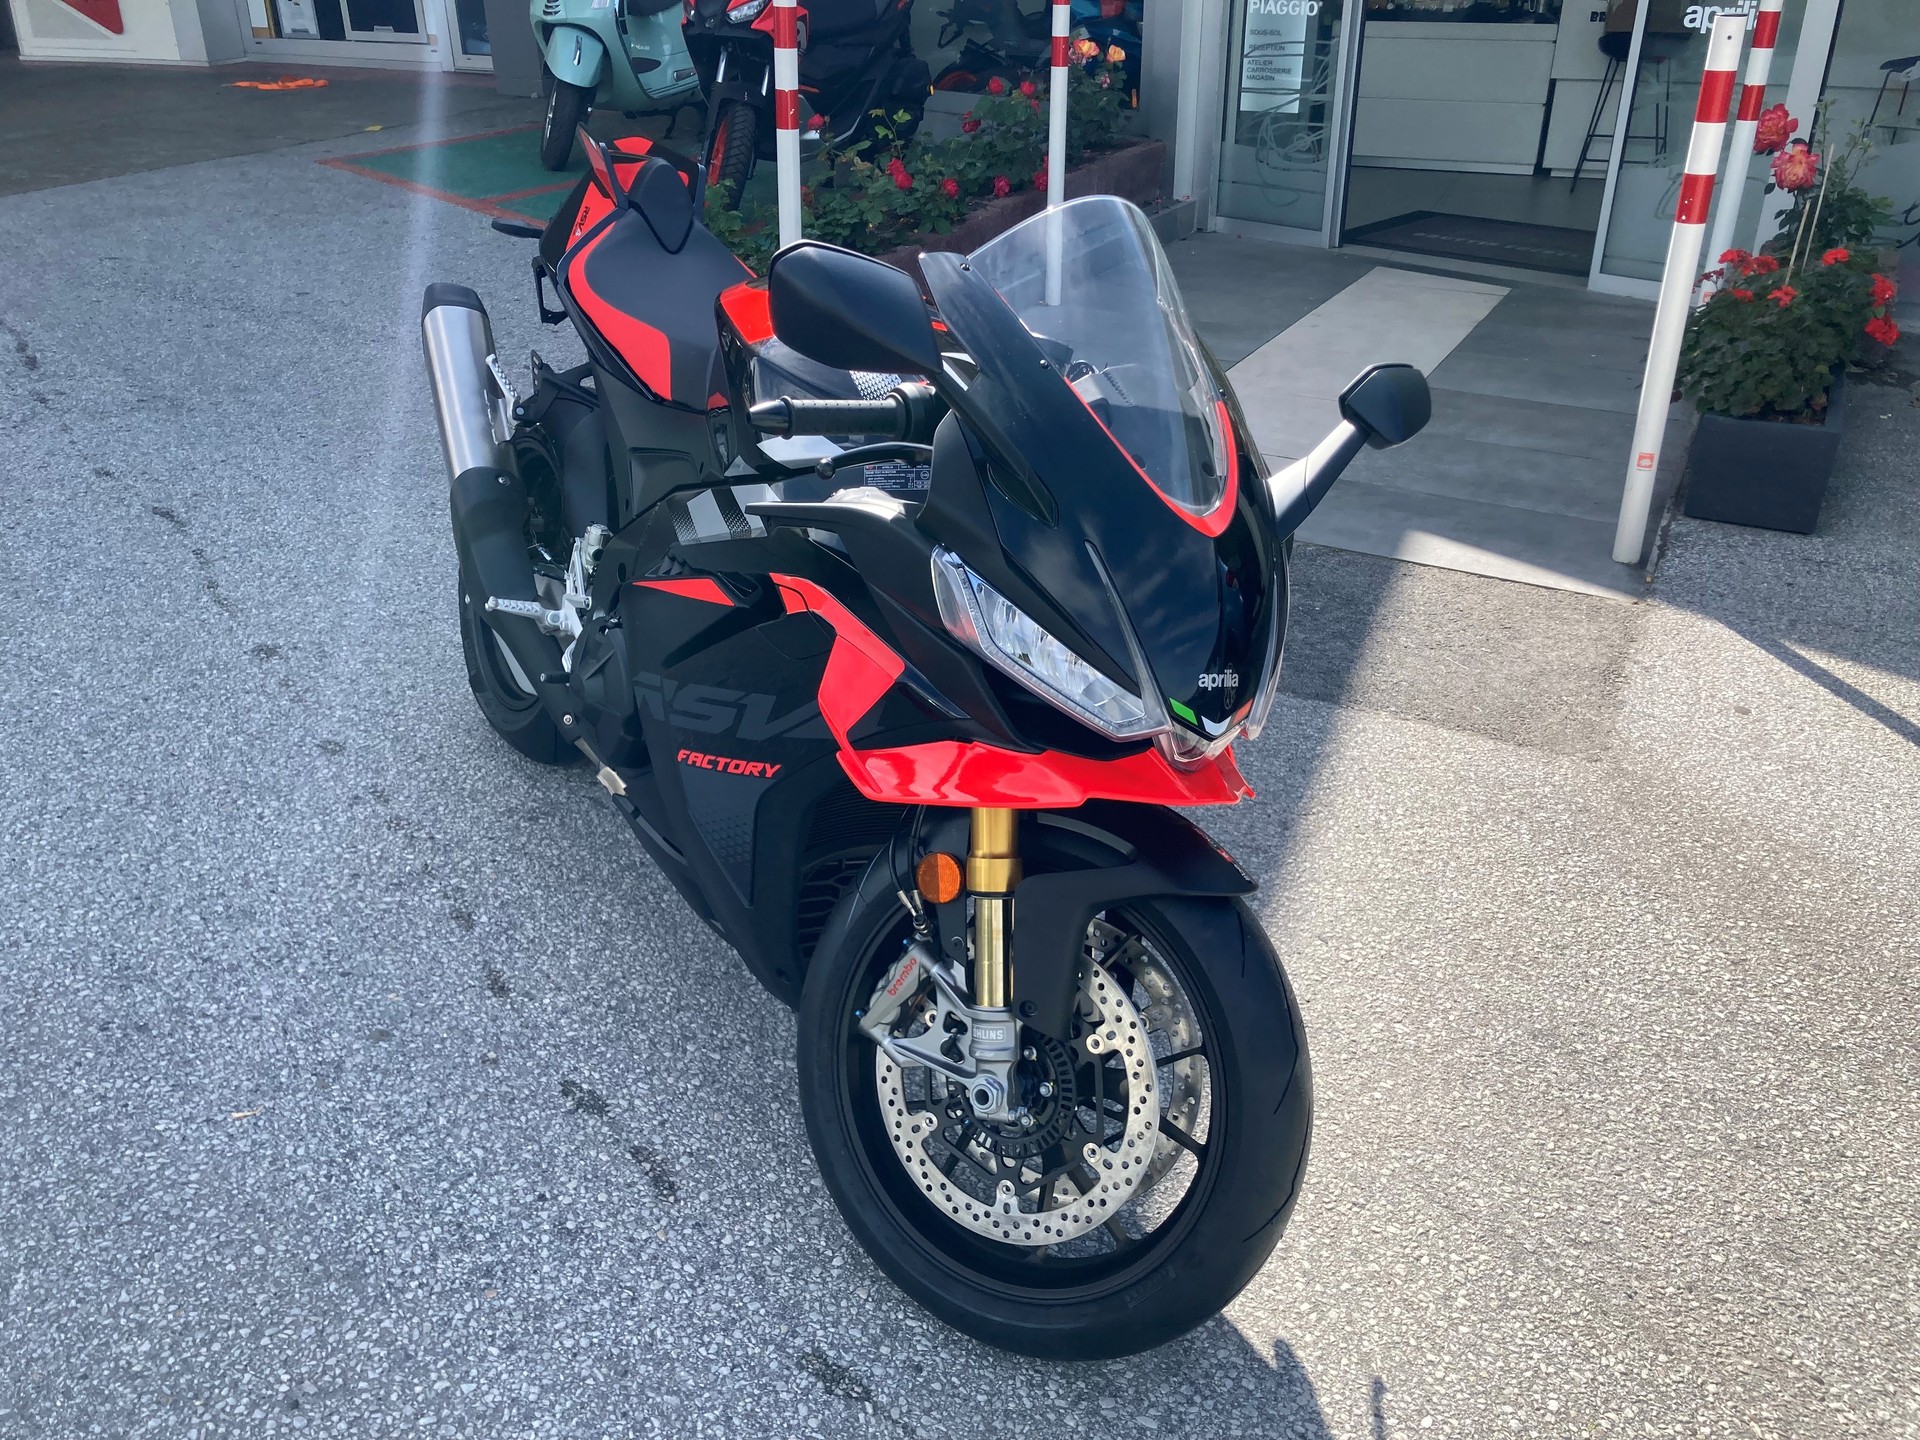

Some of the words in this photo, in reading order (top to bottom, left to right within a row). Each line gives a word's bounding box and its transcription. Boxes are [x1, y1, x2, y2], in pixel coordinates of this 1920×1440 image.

[1249, 0, 1318, 16] PIAGGIO
[1683, 0, 1759, 34] apli
[1249, 29, 1282, 37] SOUS-SOL
[1246, 67, 1292, 75] CARROSSERIE
[1198, 669, 1239, 691] aprilia
[677, 749, 782, 779] FACTORY
[886, 957, 917, 997] brembo
